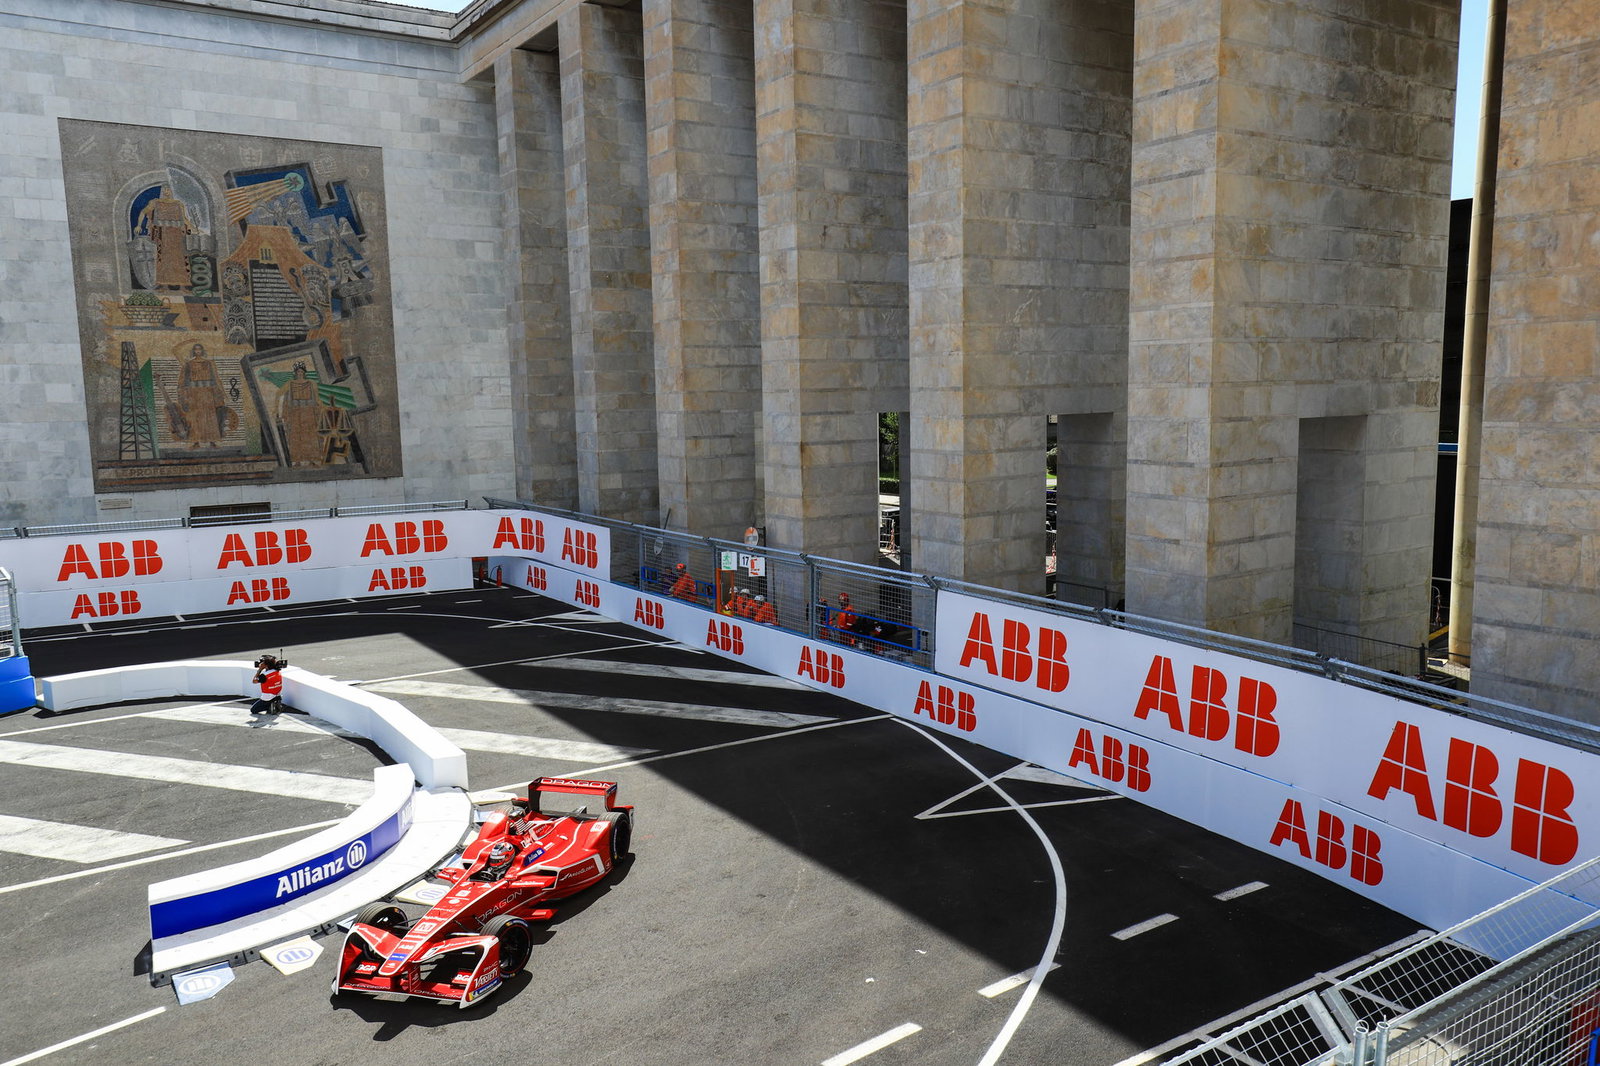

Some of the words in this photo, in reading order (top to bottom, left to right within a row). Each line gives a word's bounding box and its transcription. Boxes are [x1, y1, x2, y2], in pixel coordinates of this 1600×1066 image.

[217, 529, 312, 569] ABB
[361, 520, 448, 558] ABB
[493, 517, 545, 553] ABB
[562, 528, 598, 569] ABB
[57, 540, 163, 582] ABB
[527, 566, 546, 591] ABB
[742, 555, 750, 566] 17
[227, 577, 291, 605] ABB
[369, 566, 427, 592] ABB
[574, 580, 600, 608] ABB
[71, 591, 142, 619] ABB
[636, 598, 665, 629] ABB
[707, 619, 744, 655] ABB
[959, 613, 1070, 693] ABB
[798, 645, 846, 689] ABB
[914, 681, 977, 732] ABB
[1134, 656, 1281, 758] ABB
[1069, 728, 1151, 792] ABB
[541, 778, 612, 788] DRAGON
[1368, 721, 1579, 865] ABB
[1271, 799, 1382, 886] ABB
[275, 856, 345, 898] Allianz
[478, 889, 523, 922] DRAGON
[344, 982, 391, 990] DRAGON
[414, 989, 463, 999] DRAGON
